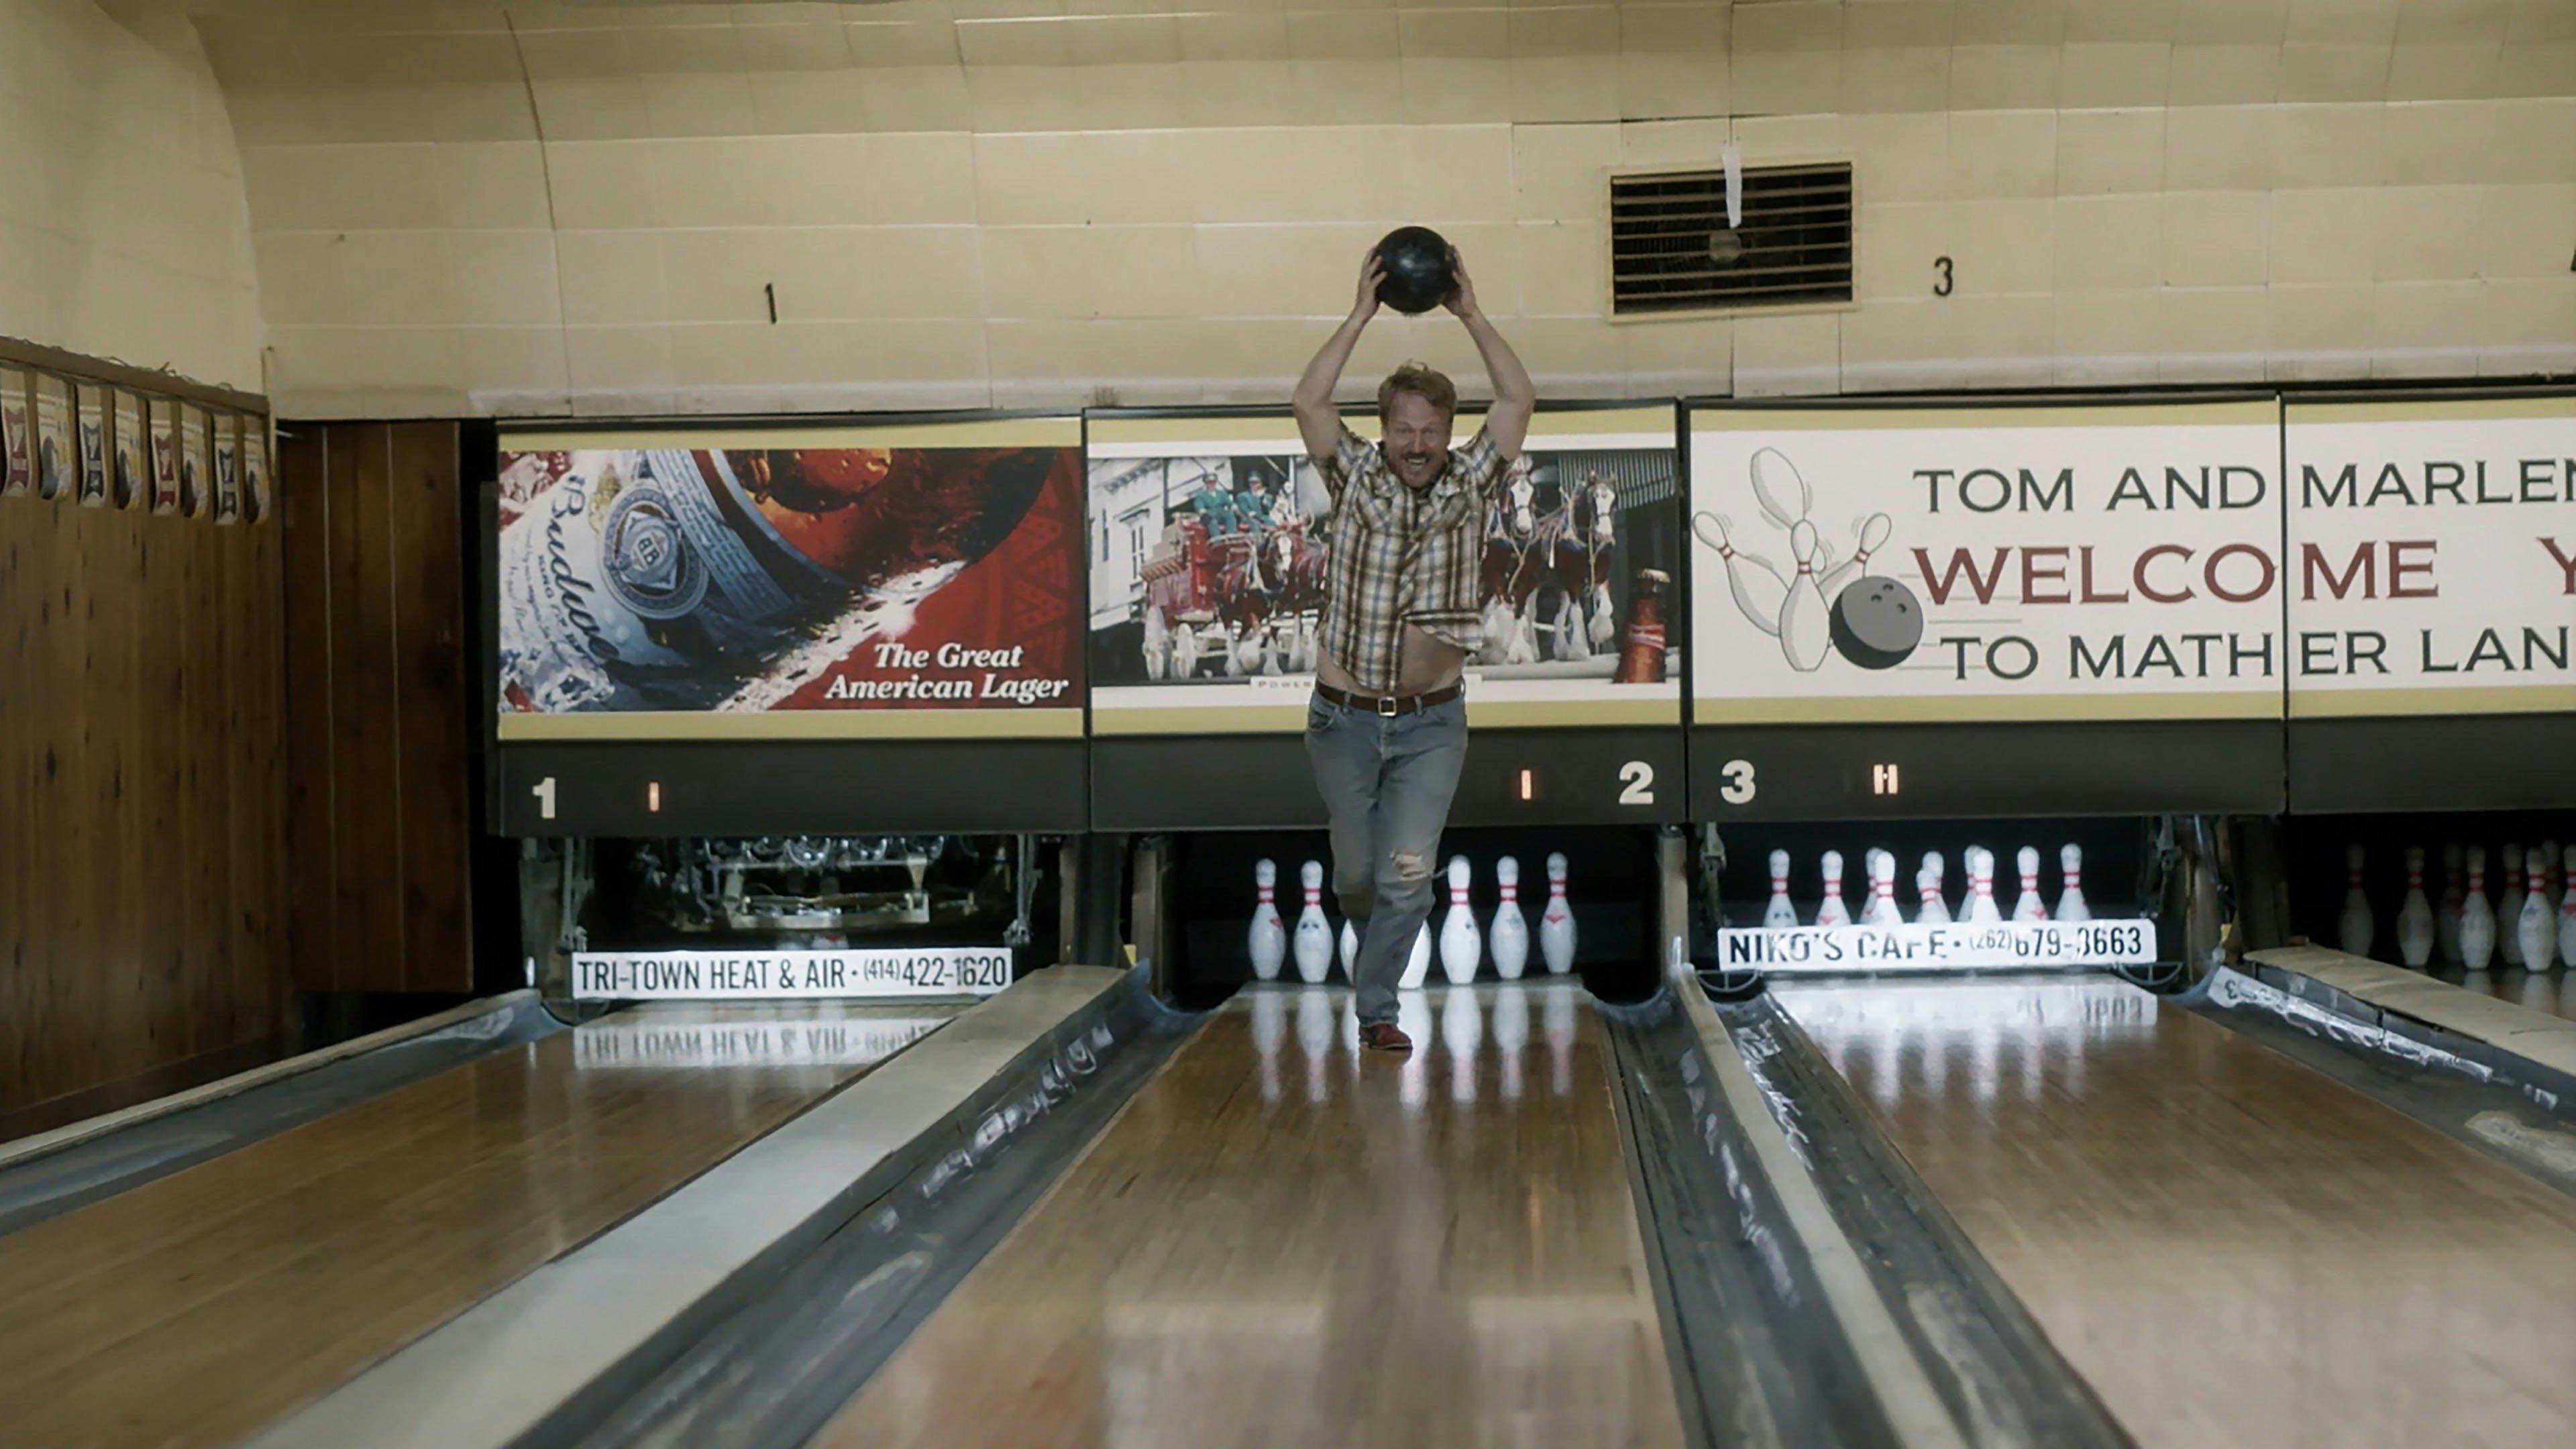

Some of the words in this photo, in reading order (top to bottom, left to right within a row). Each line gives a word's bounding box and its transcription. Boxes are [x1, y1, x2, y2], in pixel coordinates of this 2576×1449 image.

[1933, 256, 1953, 297] 3
[763, 282, 777, 325] 1
[1912, 468, 2074, 512] TOM
[2104, 466, 2267, 511] AND
[2300, 458, 2576, 508] MARLE
[1910, 539, 2439, 605] WELCOME
[873, 642, 930, 668] The
[936, 642, 1024, 669] Great
[1939, 635, 2039, 680] TO
[2068, 631, 2392, 679] MATHER
[2420, 626, 2569, 673] LAN
[824, 674, 974, 700] American
[980, 673, 1069, 705] Lager
[532, 776, 556, 819] 1
[1619, 760, 1654, 804] 2
[1720, 759, 1756, 804] 3
[1729, 930, 1843, 963] NIKO'S
[577, 960, 700, 991] TRI-TOWN
[710, 959, 771, 989] HEAT
[778, 959, 796, 989] &
[804, 959, 846, 988] AIR
